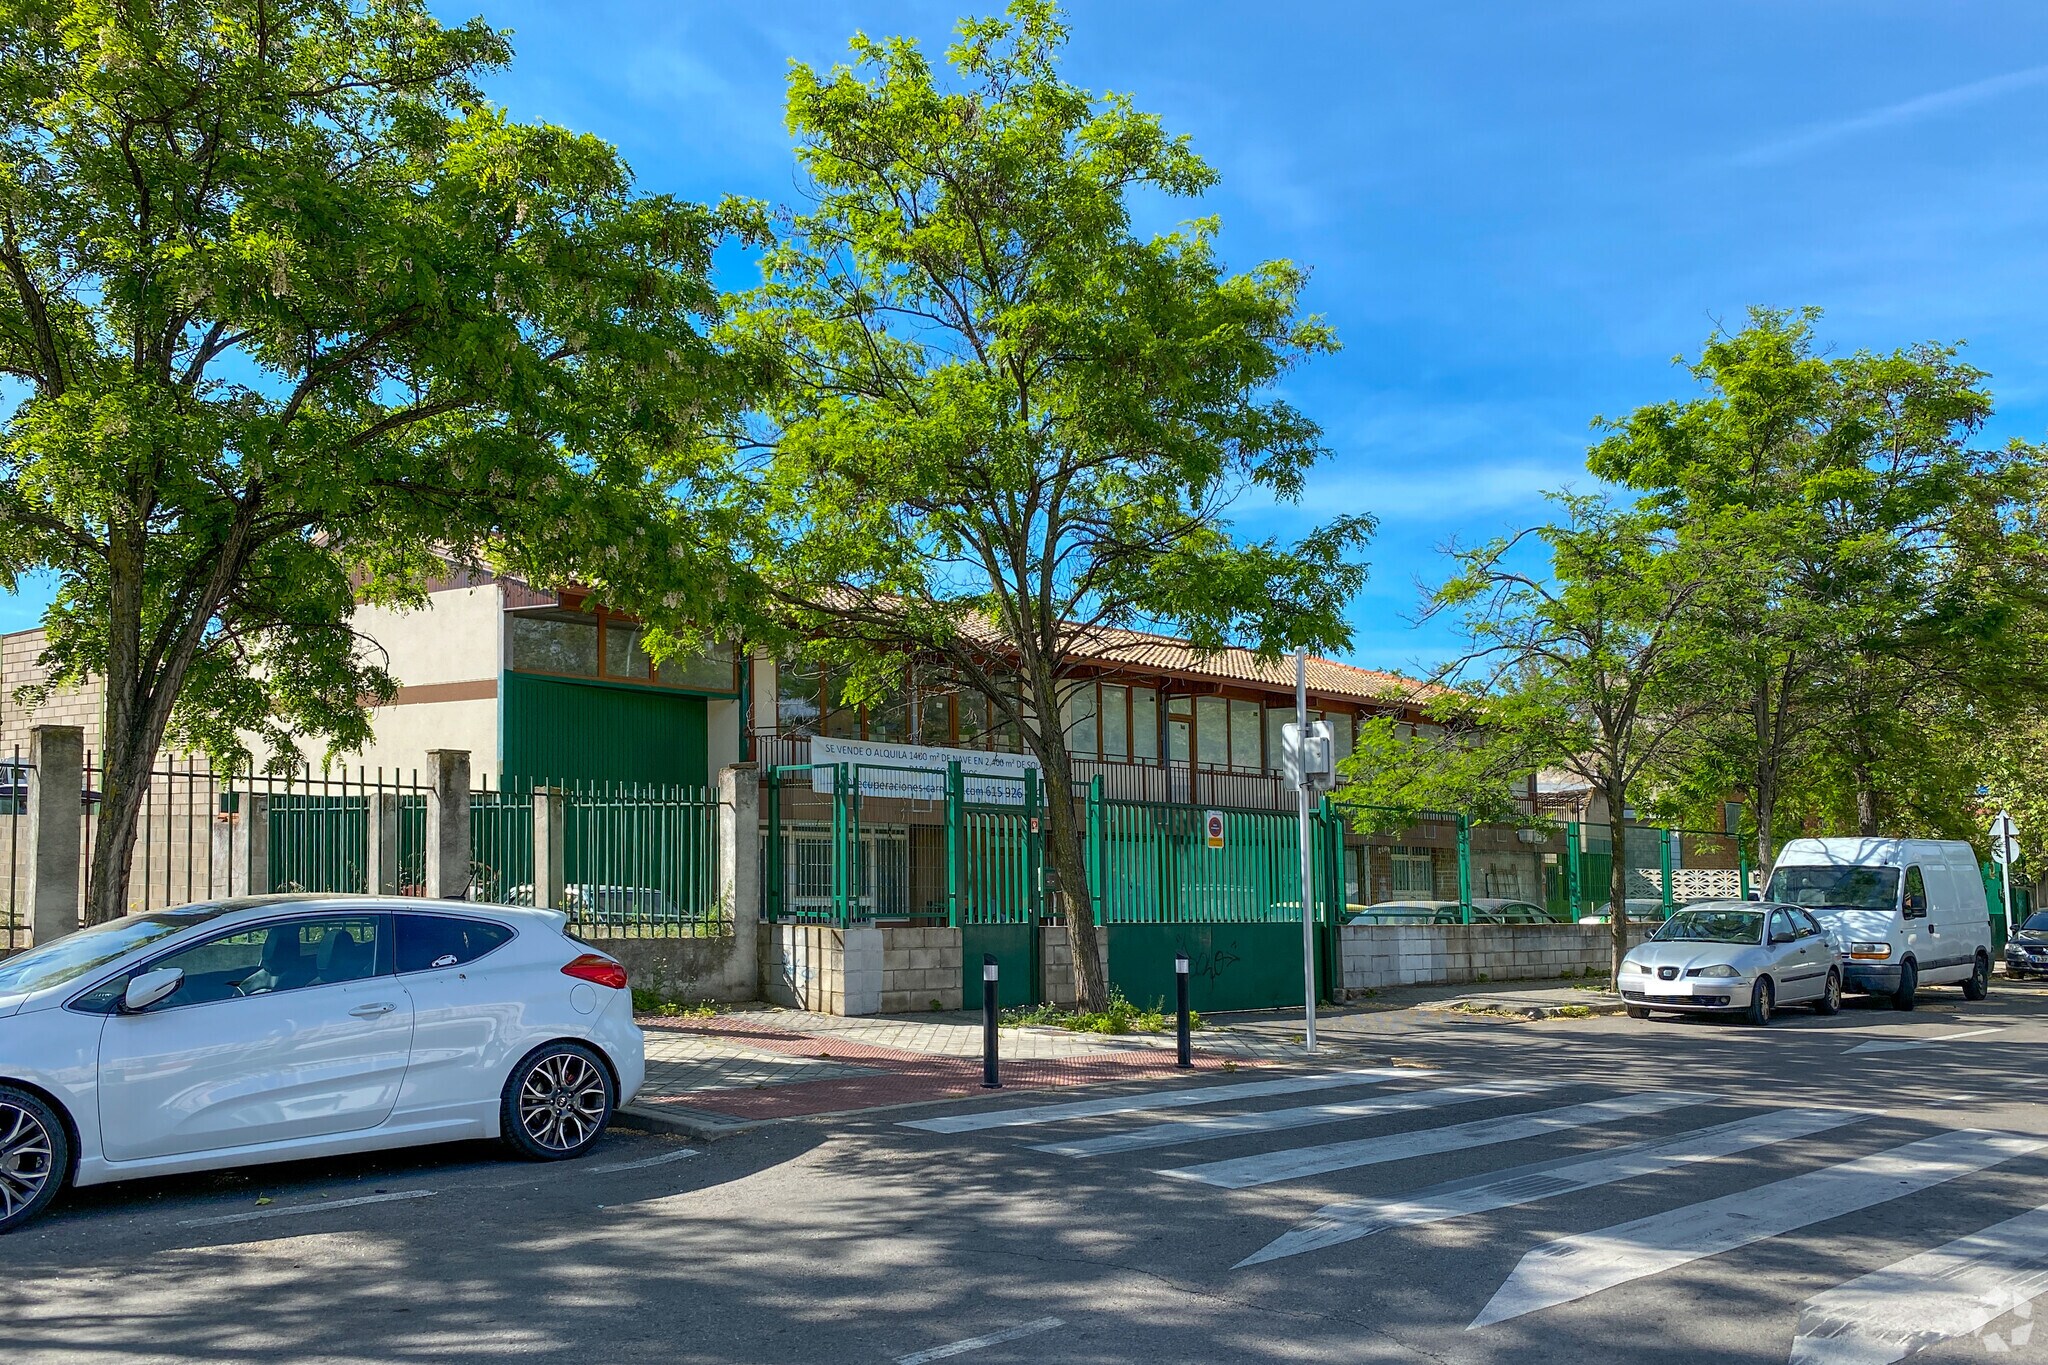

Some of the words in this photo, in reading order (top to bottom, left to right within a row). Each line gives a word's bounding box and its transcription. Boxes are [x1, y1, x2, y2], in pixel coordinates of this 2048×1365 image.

[825, 744, 835, 753] SE
[836, 745, 863, 755] VENDE
[865, 748, 872, 756] O
[874, 748, 908, 759] ALQUILA
[941, 753, 950, 762] DE
[953, 755, 973, 765] NAVE
[974, 757, 983, 765] EN
[1016, 761, 1025, 769] DE
[985, 785, 1003, 797] 615
[1005, 787, 1023, 798] 926
